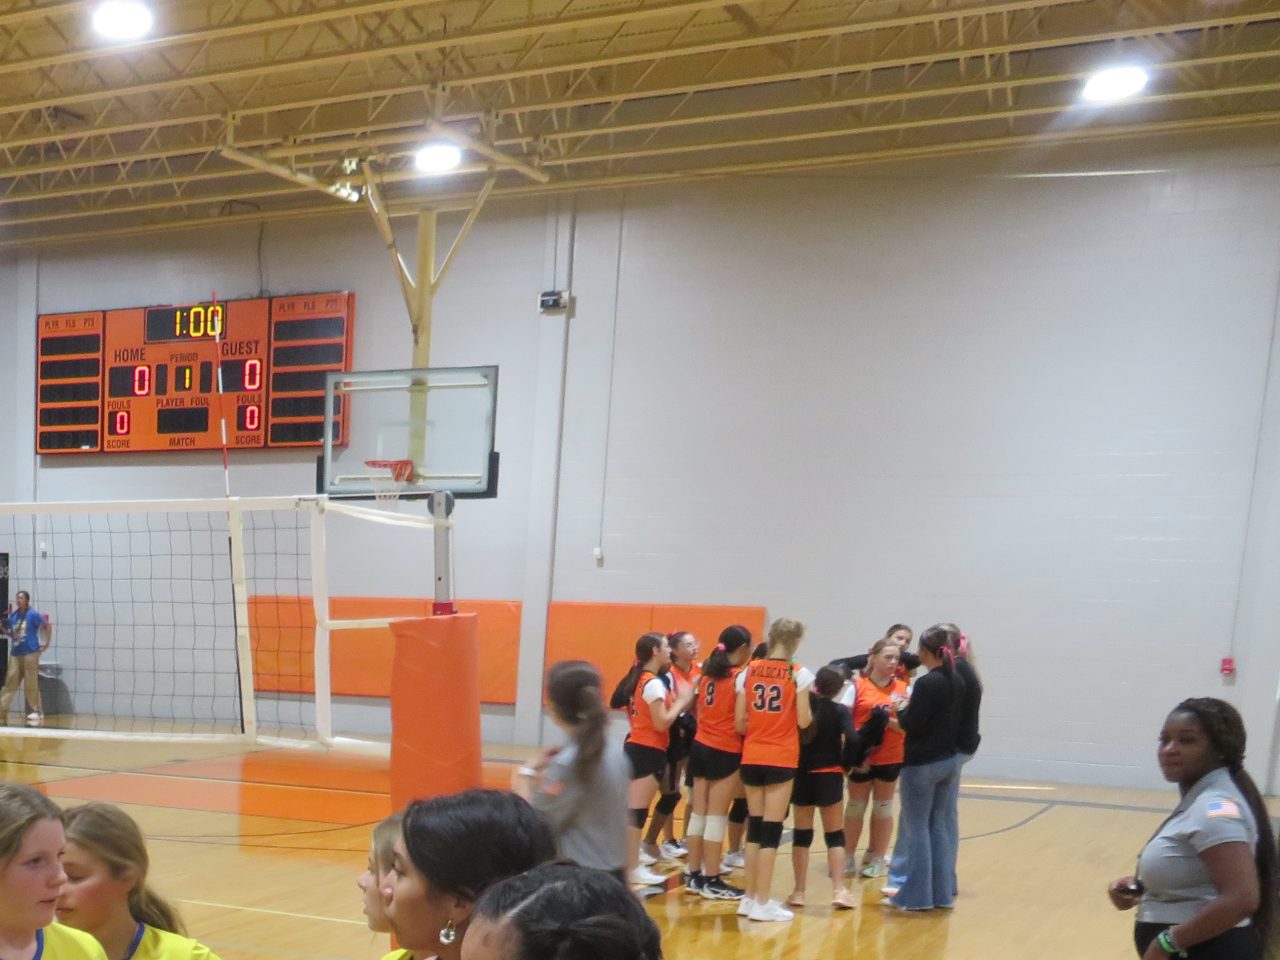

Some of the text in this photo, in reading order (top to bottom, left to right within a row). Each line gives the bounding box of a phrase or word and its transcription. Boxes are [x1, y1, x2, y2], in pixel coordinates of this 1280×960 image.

[175, 305, 222, 337] 1:00
[114, 348, 146, 362] HOME
[221, 341, 260, 356] GUEST
[170, 353, 198, 362] PERIOD
[134, 366, 149, 395] 0
[244, 359, 261, 390] 0
[107, 400, 131, 410] FOULS
[156, 398, 185, 407] PLAYER
[237, 394, 262, 405] FOULS
[116, 411, 128, 434] 0
[245, 405, 259, 430] 0
[106, 440, 130, 449] SCORE
[169, 437, 195, 446] MATCH
[235, 435, 261, 445] SCORE
[753, 683, 783, 713] 32
